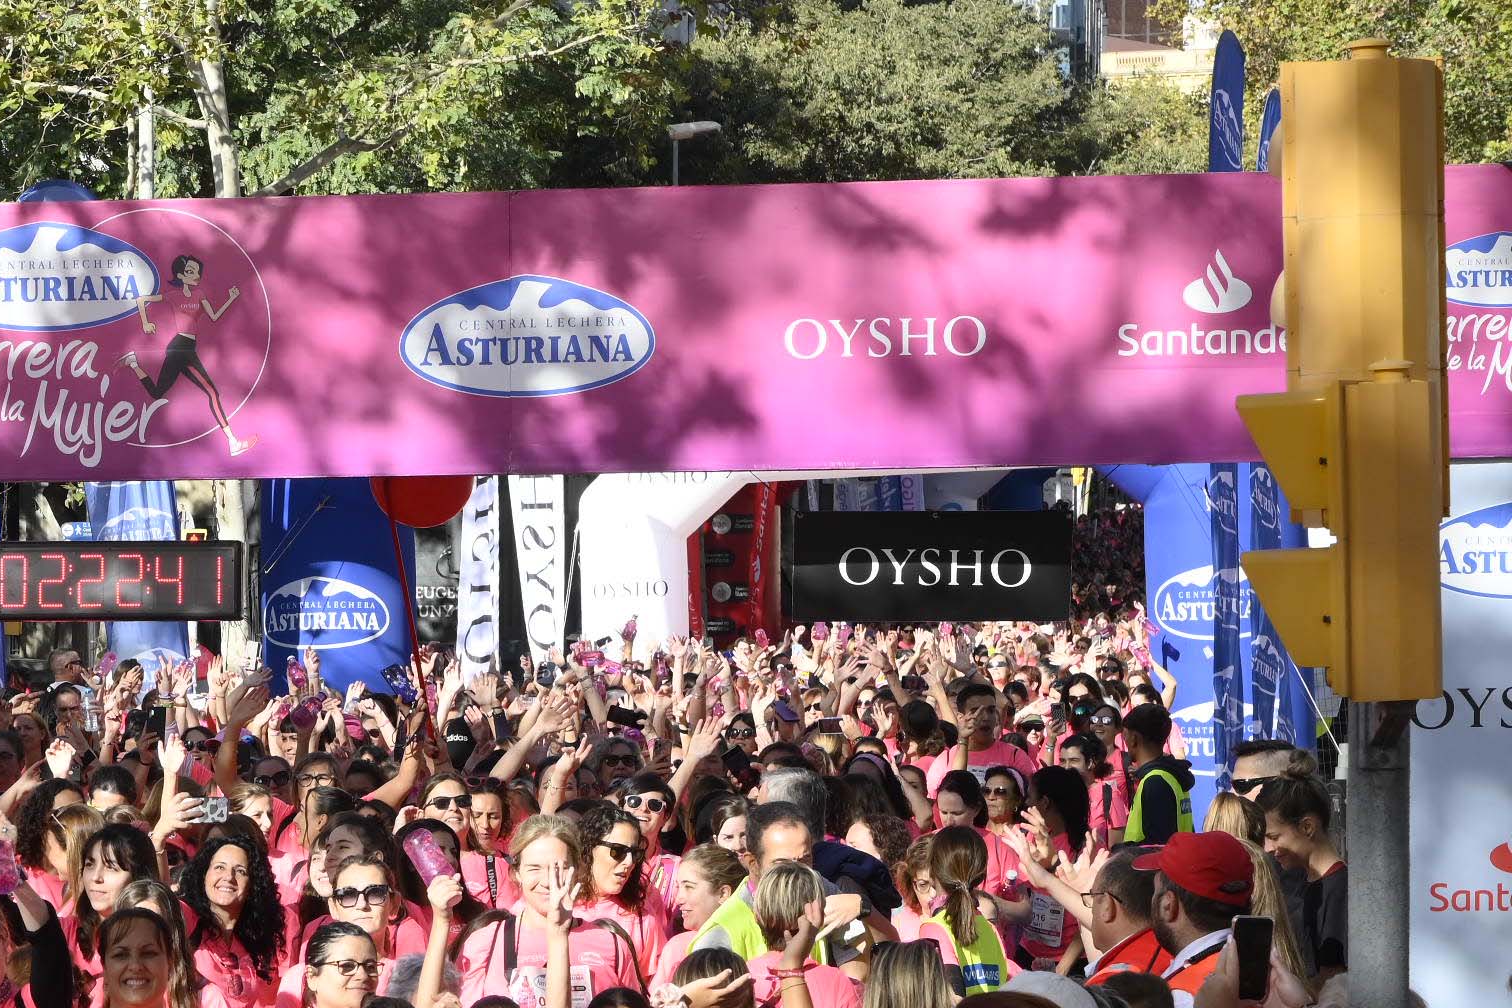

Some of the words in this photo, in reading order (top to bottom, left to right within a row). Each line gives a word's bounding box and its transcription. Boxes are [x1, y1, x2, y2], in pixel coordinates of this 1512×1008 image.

[62, 258, 135, 270] LECHERA
[459, 318, 537, 331] CENTRAL
[546, 315, 626, 329] LECHERA
[785, 315, 987, 360] OYSHO
[420, 323, 635, 367] ASTURIANA
[0, 384, 25, 423] la
[20, 373, 170, 468] Mujer
[838, 547, 1032, 588] OYSHO
[268, 606, 381, 633] ASTURIANA
[327, 600, 376, 609] LECHERA
